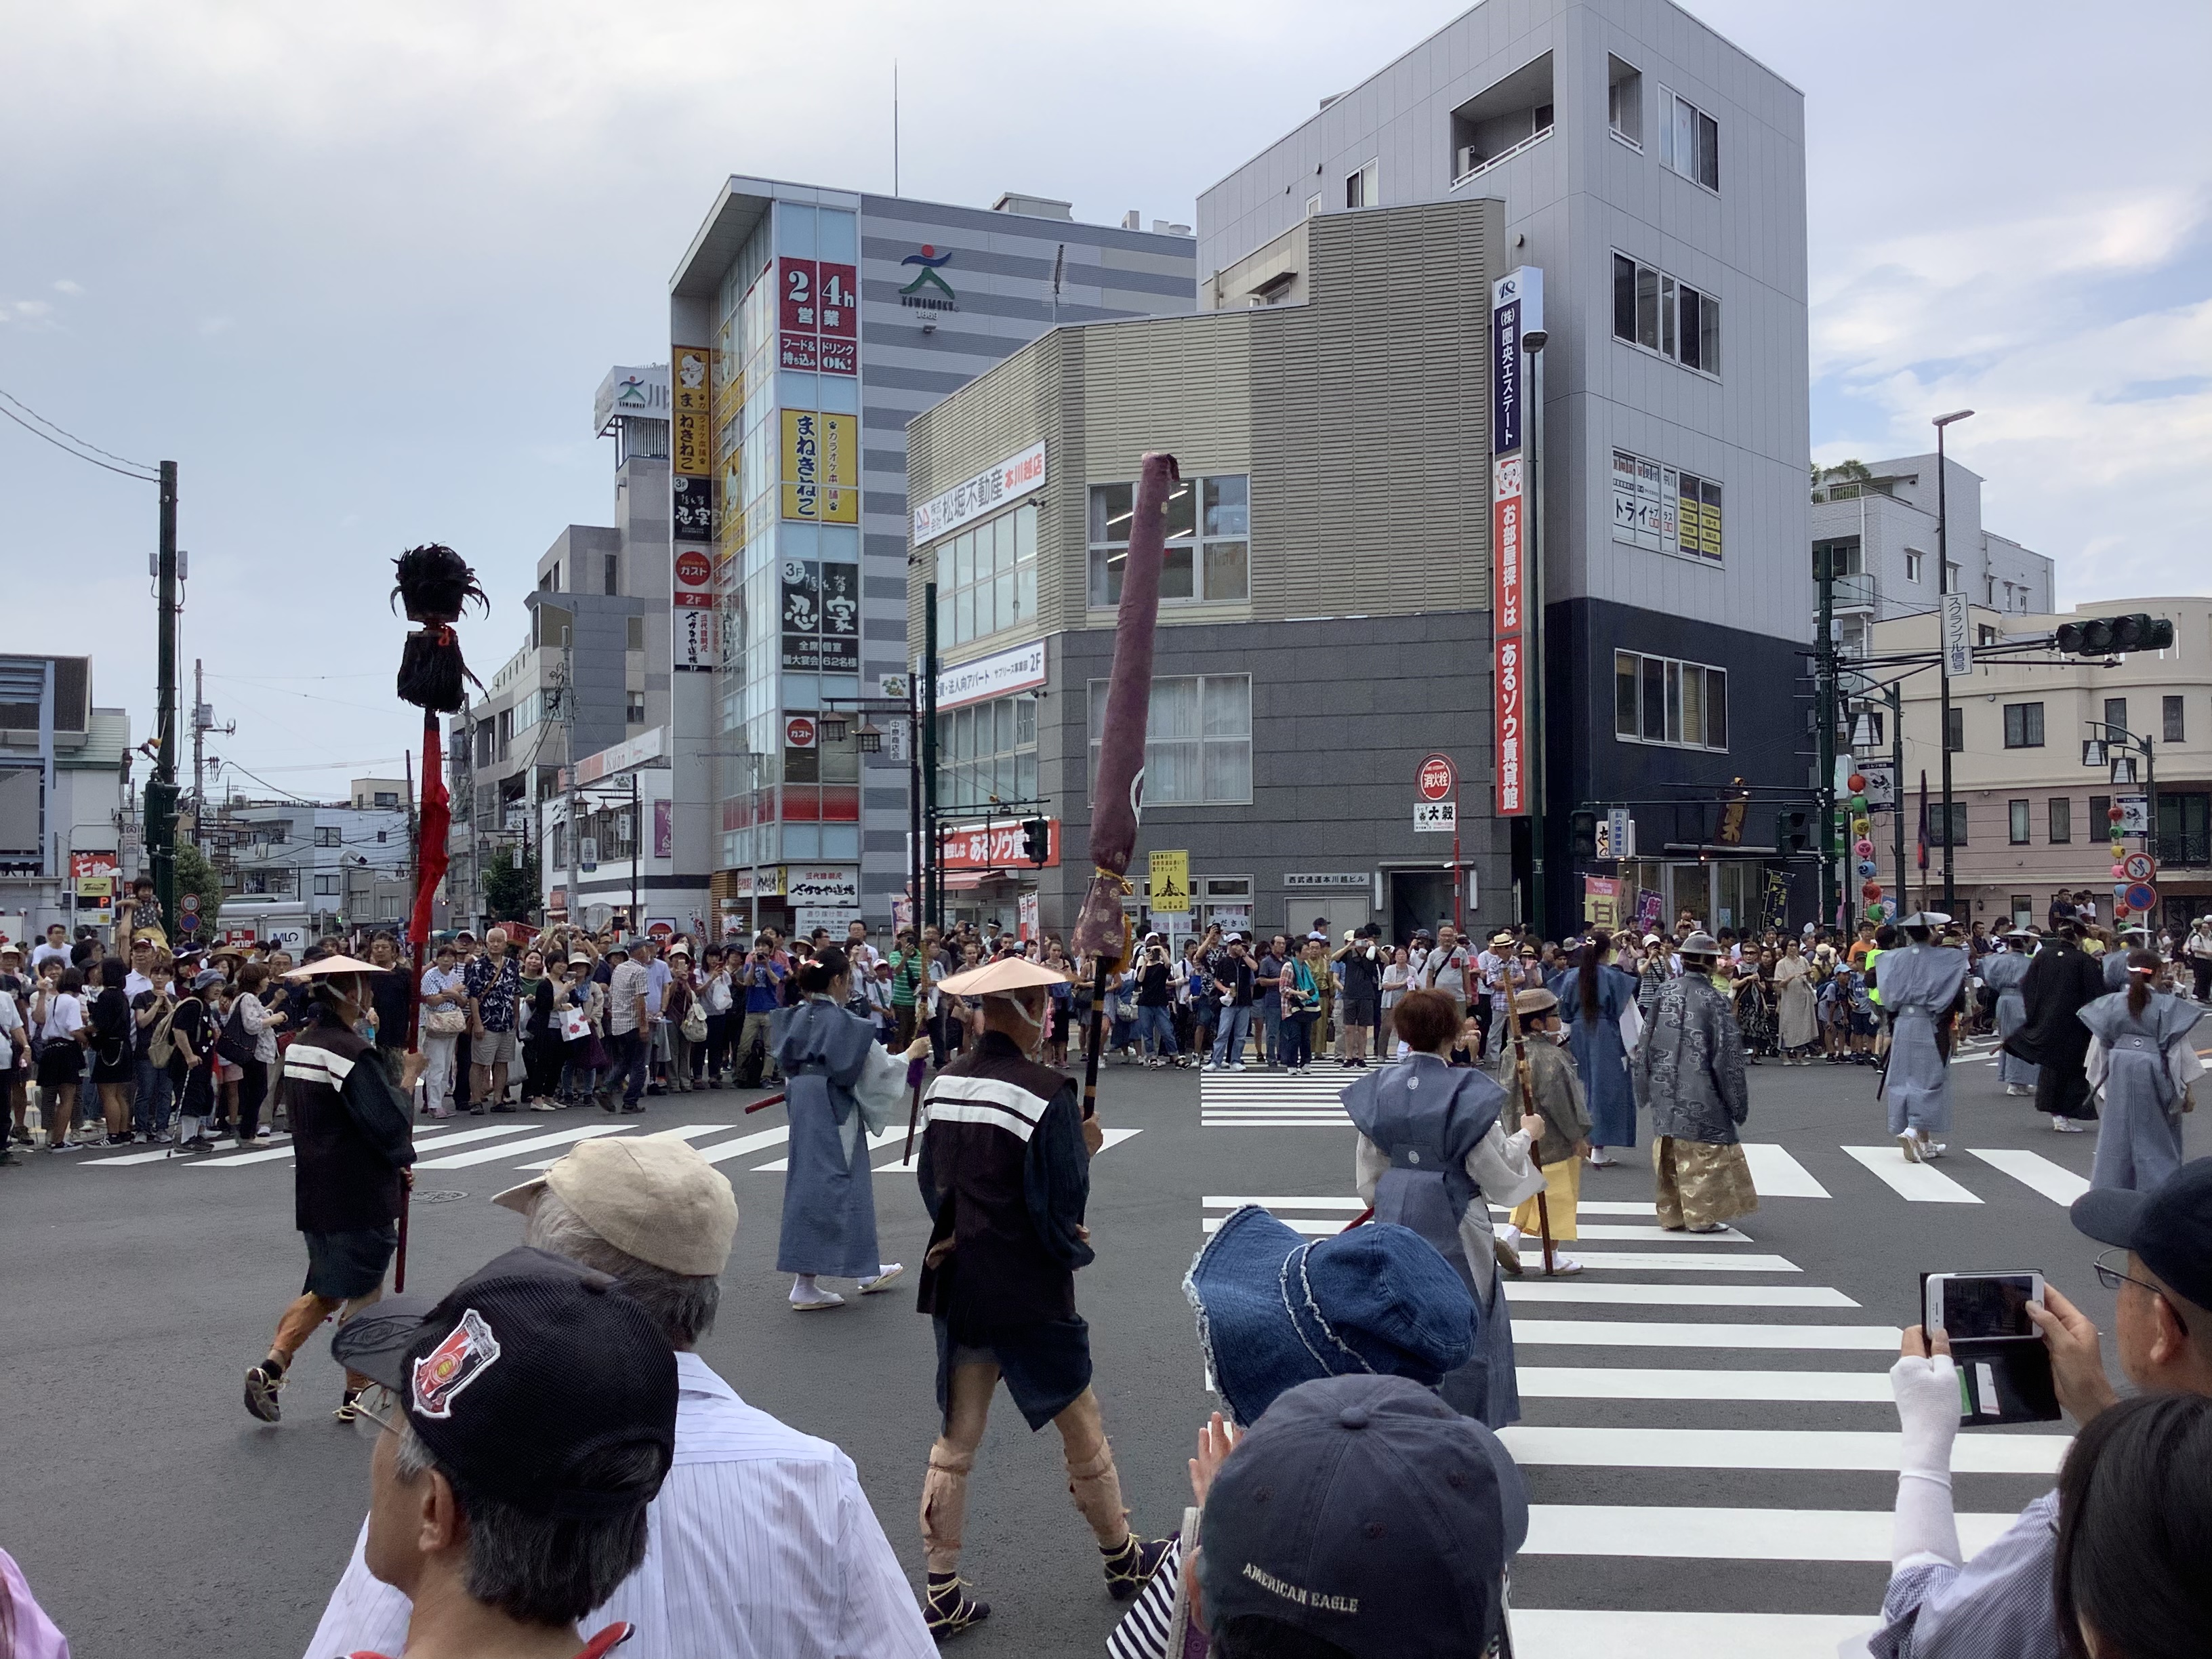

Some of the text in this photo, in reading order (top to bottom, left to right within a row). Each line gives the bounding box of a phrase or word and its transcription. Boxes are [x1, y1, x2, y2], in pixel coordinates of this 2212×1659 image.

[787, 270, 855, 308] 24h
[797, 306, 840, 327] 営業
[916, 310, 938, 320] 1869
[680, 392, 694, 470] まねきねこ
[796, 415, 817, 516] まねきねこ
[1004, 453, 1043, 490] 本川越店
[676, 478, 687, 488] 3F
[942, 468, 1003, 527] 松堀不動産
[675, 506, 711, 527] 忍家
[680, 567, 708, 577] ガスト
[785, 562, 803, 577] 3F
[1502, 504, 1517, 628] お部屋探しは
[685, 594, 702, 605] 2F
[784, 594, 857, 632] 忍家
[1948, 597, 1965, 672] スクランブル信号
[1030, 652, 1042, 672] 2F
[1502, 642, 1519, 811] あるゾウ賃貸館
[1424, 771, 1448, 789] 消火栓
[790, 883, 855, 896] さかなや道場
[1288, 876, 1366, 884] 西武通運本川越ビル
[100, 897, 109, 908] P
[186, 899, 196, 908] 30
[1242, 1562, 1359, 1613] AMERICAN EAGLE
